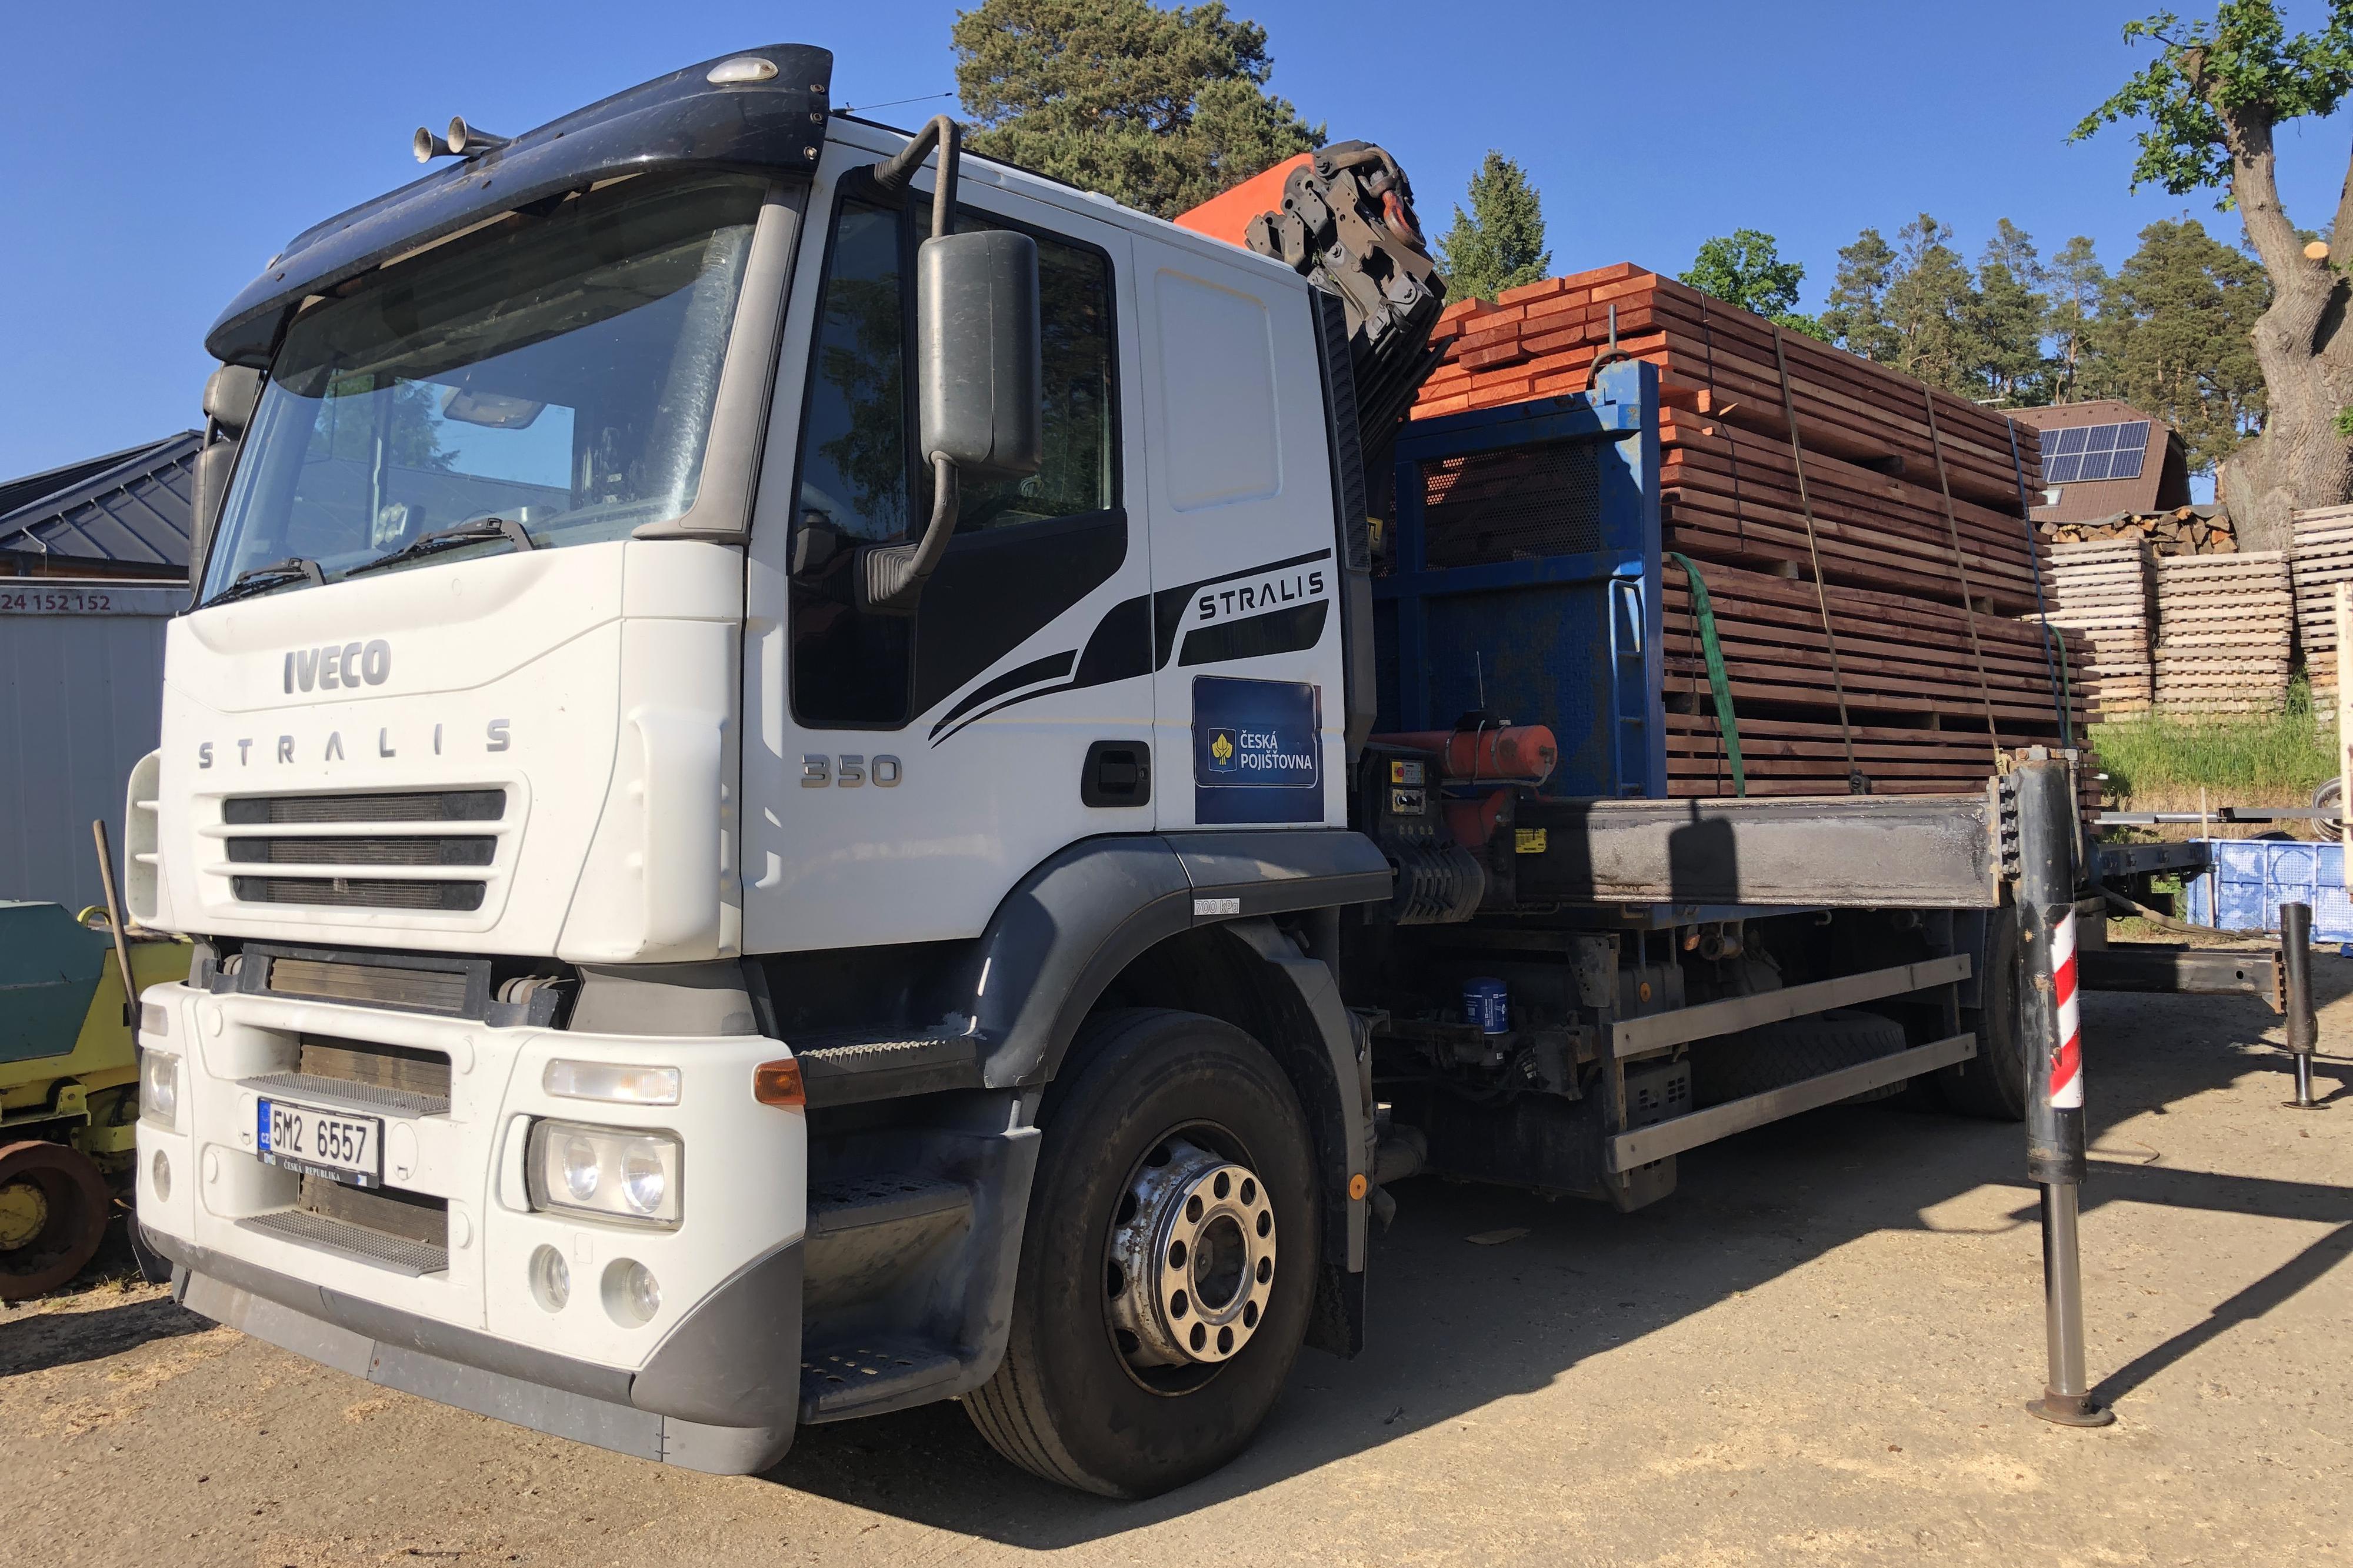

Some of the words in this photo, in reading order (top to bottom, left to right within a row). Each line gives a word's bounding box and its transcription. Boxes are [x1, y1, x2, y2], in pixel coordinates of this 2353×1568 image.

[1, 594, 26, 610] 24
[34, 595, 69, 610] 152
[76, 595, 111, 610] 152
[1199, 571, 1324, 620] STRALIS
[284, 639, 391, 694] IVECO
[199, 719, 511, 769] STRALIS
[1240, 729, 1278, 749] ČESKÁ
[801, 754, 902, 788] 350
[1241, 750, 1312, 771] POJIŠŤOVNA
[1196, 900, 1217, 913] 700
[1219, 899, 1238, 913] kPa
[261, 1132, 270, 1143] CZ
[274, 1109, 302, 1152] 5M2
[318, 1120, 366, 1164] 6557
[284, 1159, 302, 1173] ČESKÁ
[305, 1166, 341, 1182] REPUBLIKA
